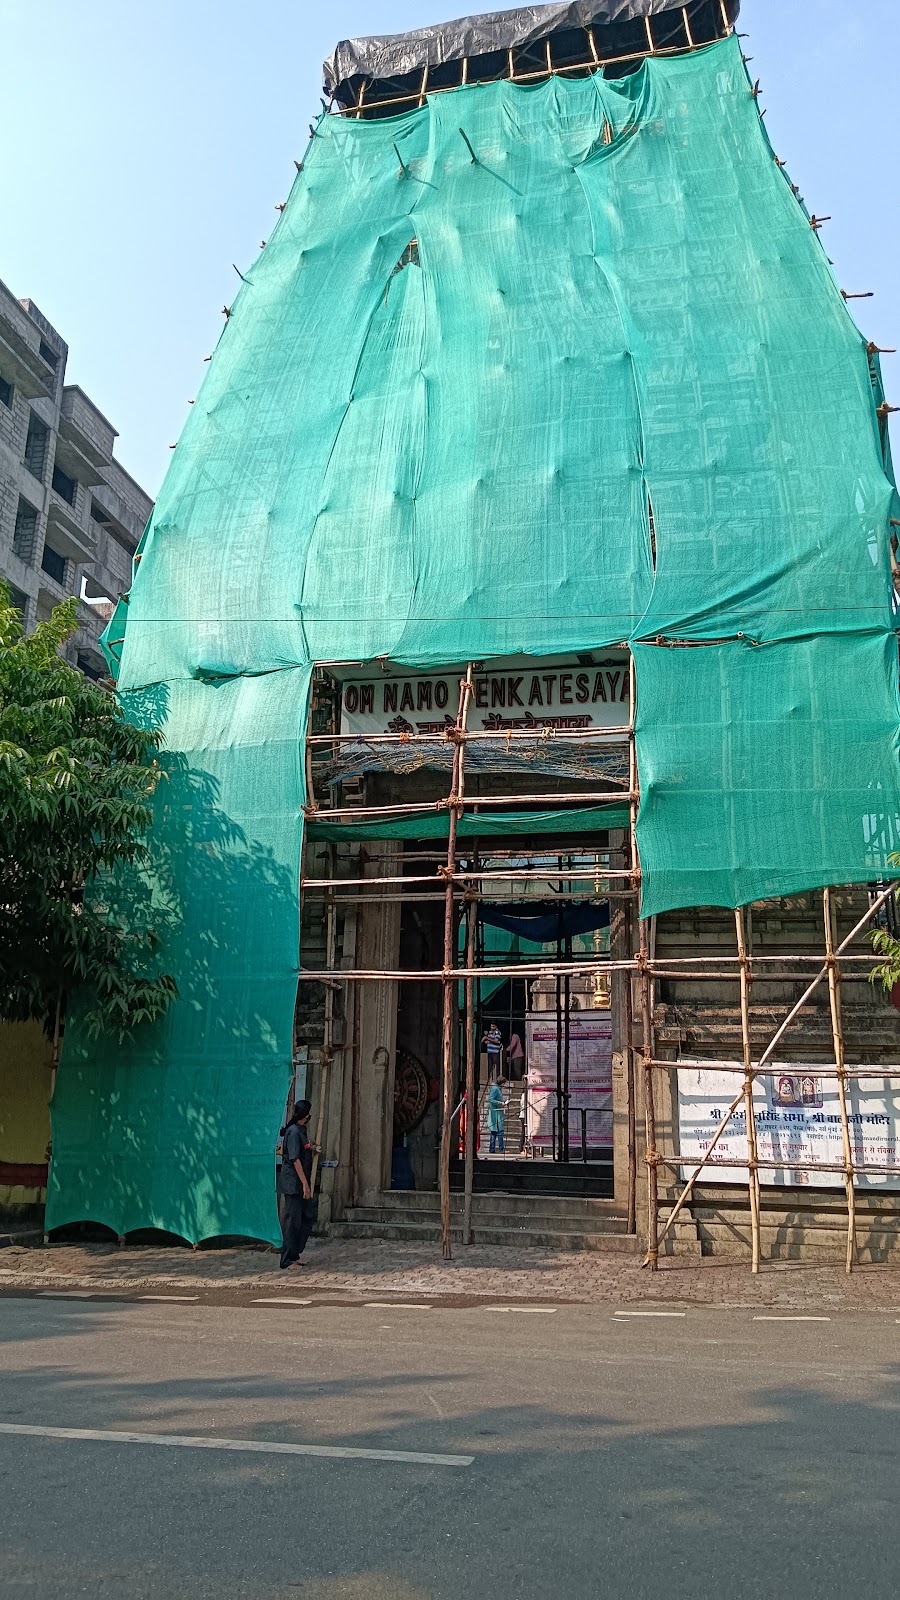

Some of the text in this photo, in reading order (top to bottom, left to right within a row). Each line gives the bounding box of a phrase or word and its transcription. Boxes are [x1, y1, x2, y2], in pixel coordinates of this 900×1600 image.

[344, 669, 631, 714] OM NAMO ENKATESAYA
[710, 1108, 721, 1119] श्री
[812, 1112, 824, 1123] श्री
[866, 1114, 891, 1125] मंदिर
